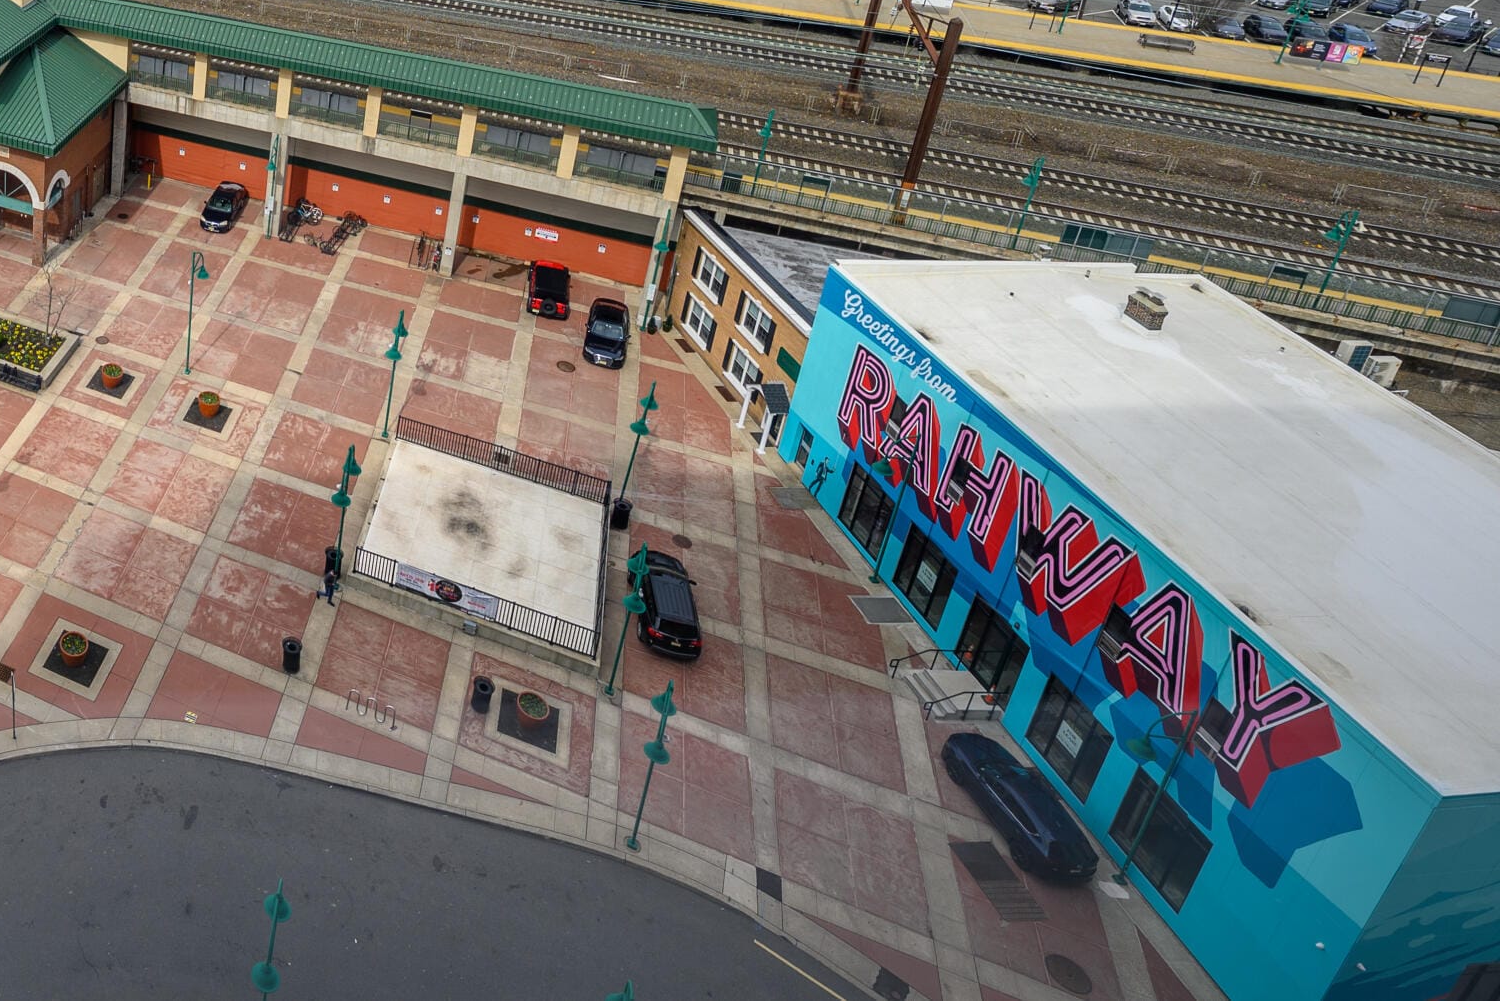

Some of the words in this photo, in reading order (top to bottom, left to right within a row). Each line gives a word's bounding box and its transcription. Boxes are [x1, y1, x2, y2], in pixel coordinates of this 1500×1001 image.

[841, 289, 917, 363] Greetings
[910, 358, 957, 403] from
[837, 343, 1329, 773] RAHWAY
